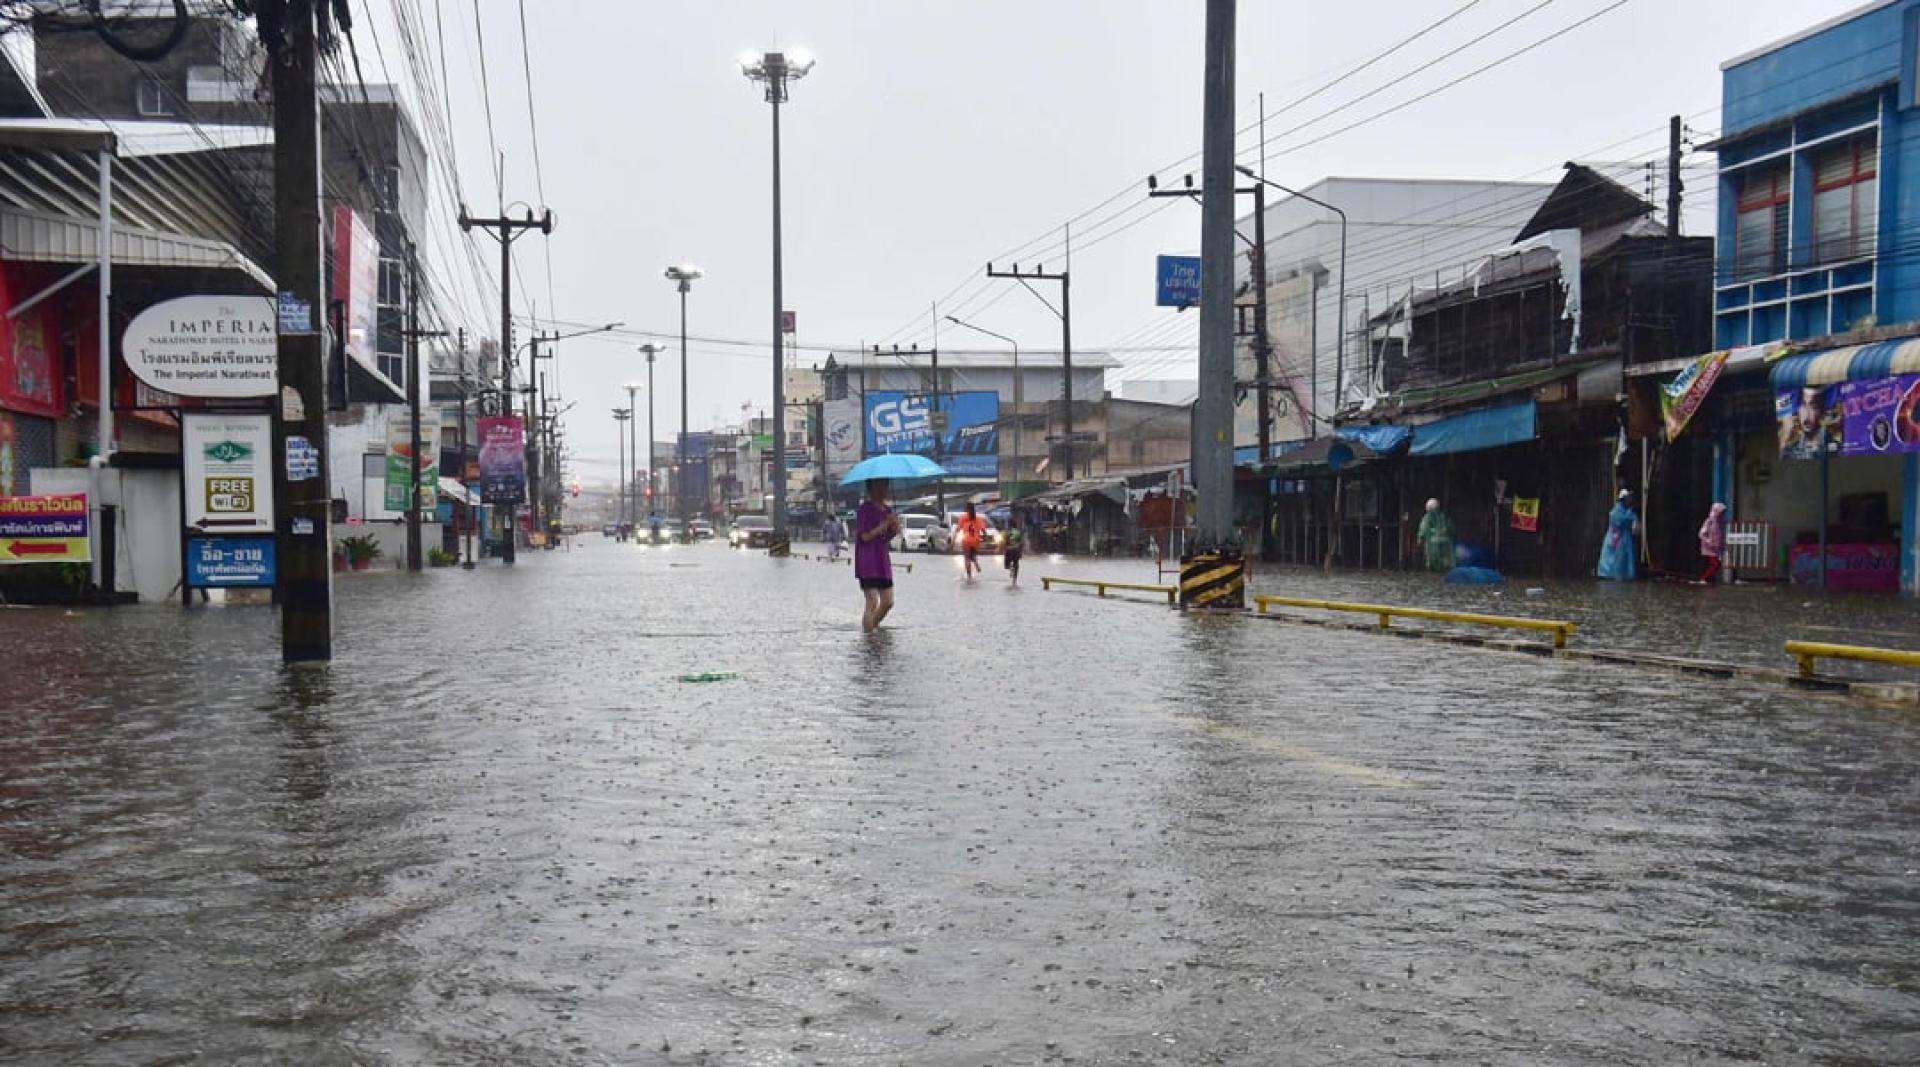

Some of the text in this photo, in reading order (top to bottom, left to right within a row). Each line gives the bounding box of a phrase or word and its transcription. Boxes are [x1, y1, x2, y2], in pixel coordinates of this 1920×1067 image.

[153, 369, 173, 378] The
[176, 369, 218, 381] Imperial
[869, 397, 929, 433] GS
[211, 480, 250, 492] FREE
